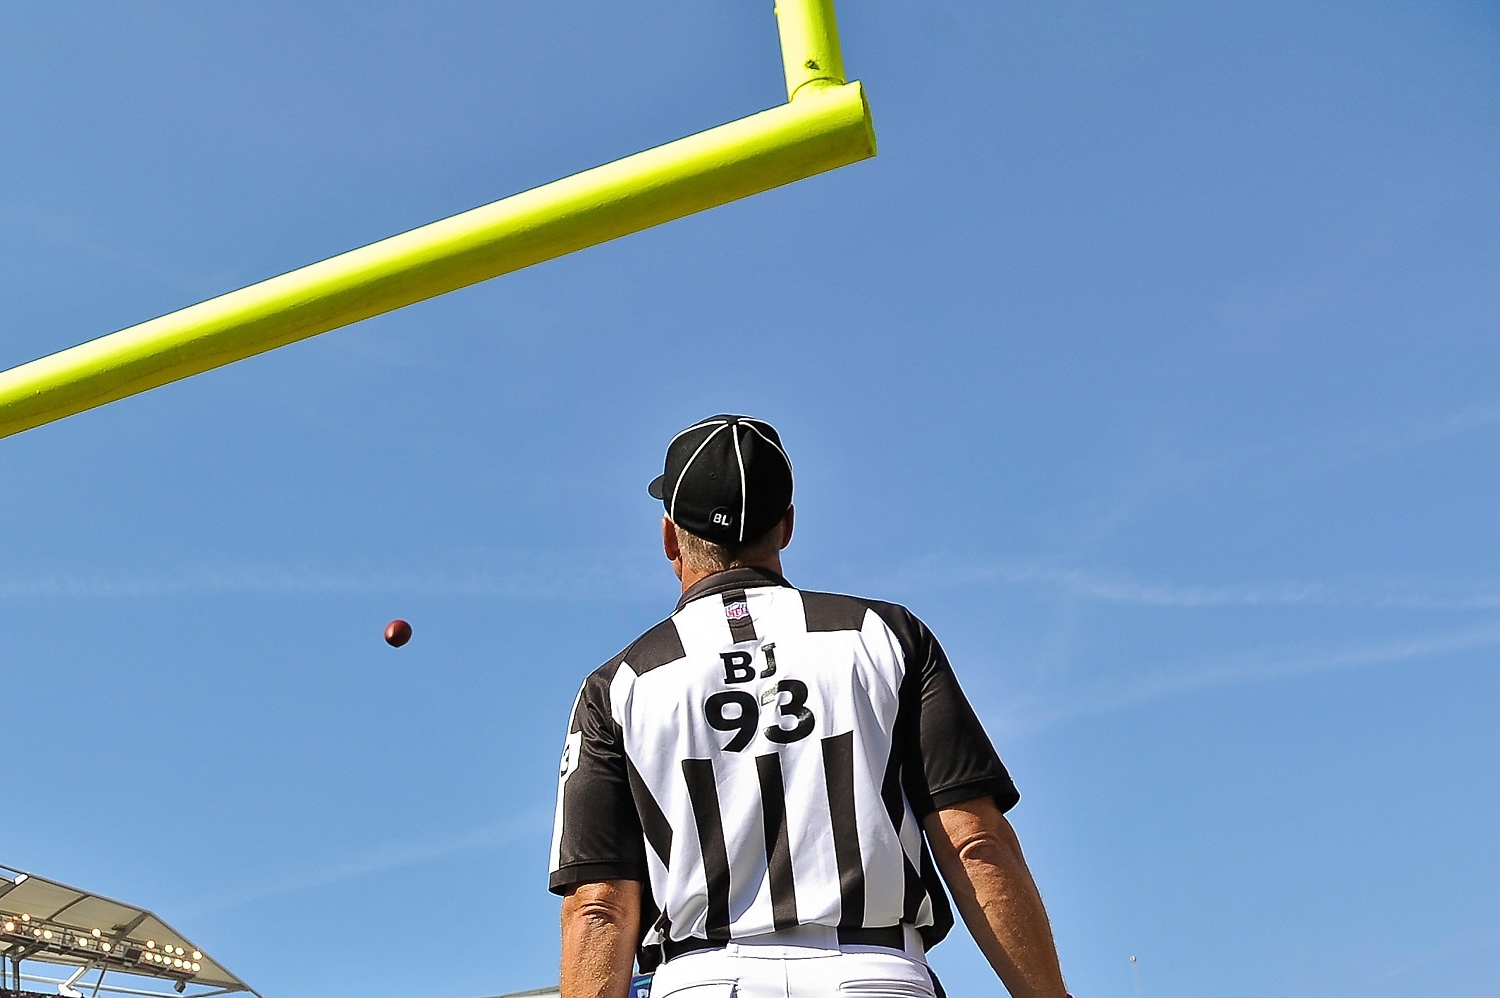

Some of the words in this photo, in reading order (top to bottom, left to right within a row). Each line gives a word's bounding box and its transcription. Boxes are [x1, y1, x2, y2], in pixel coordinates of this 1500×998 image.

[713, 513, 729, 526] BL
[720, 642, 776, 684] BJ
[705, 679, 816, 753] 93
